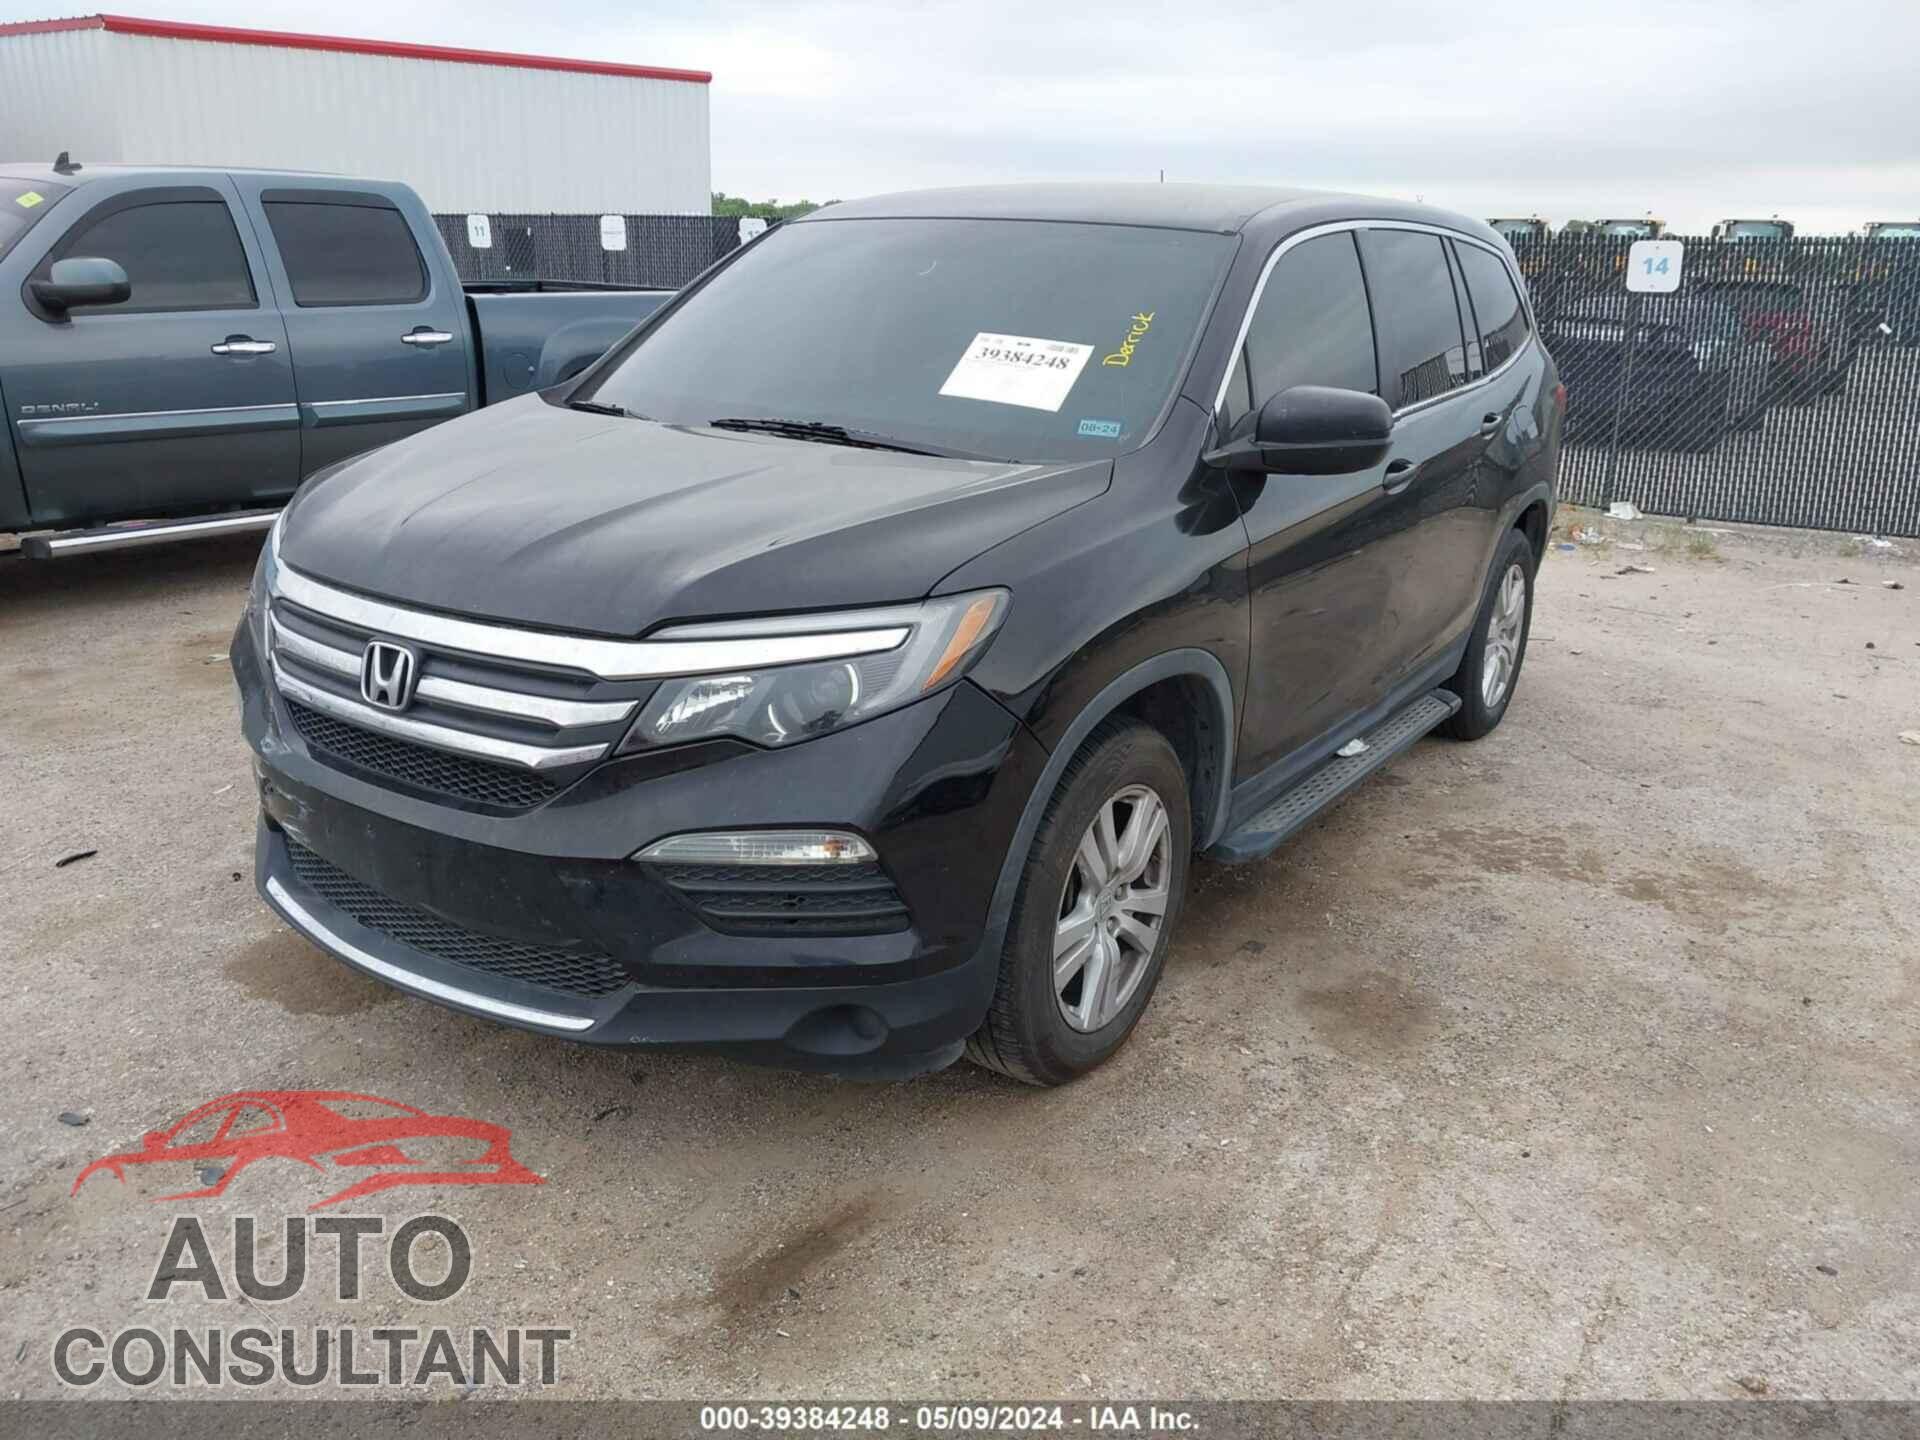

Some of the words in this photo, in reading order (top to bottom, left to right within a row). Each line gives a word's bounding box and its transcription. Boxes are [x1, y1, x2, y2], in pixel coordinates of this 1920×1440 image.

[474, 225, 485, 238] 11
[1643, 256, 1669, 274] 14
[1102, 311, 1156, 367] Derrick
[975, 346, 1071, 370] 39384248
